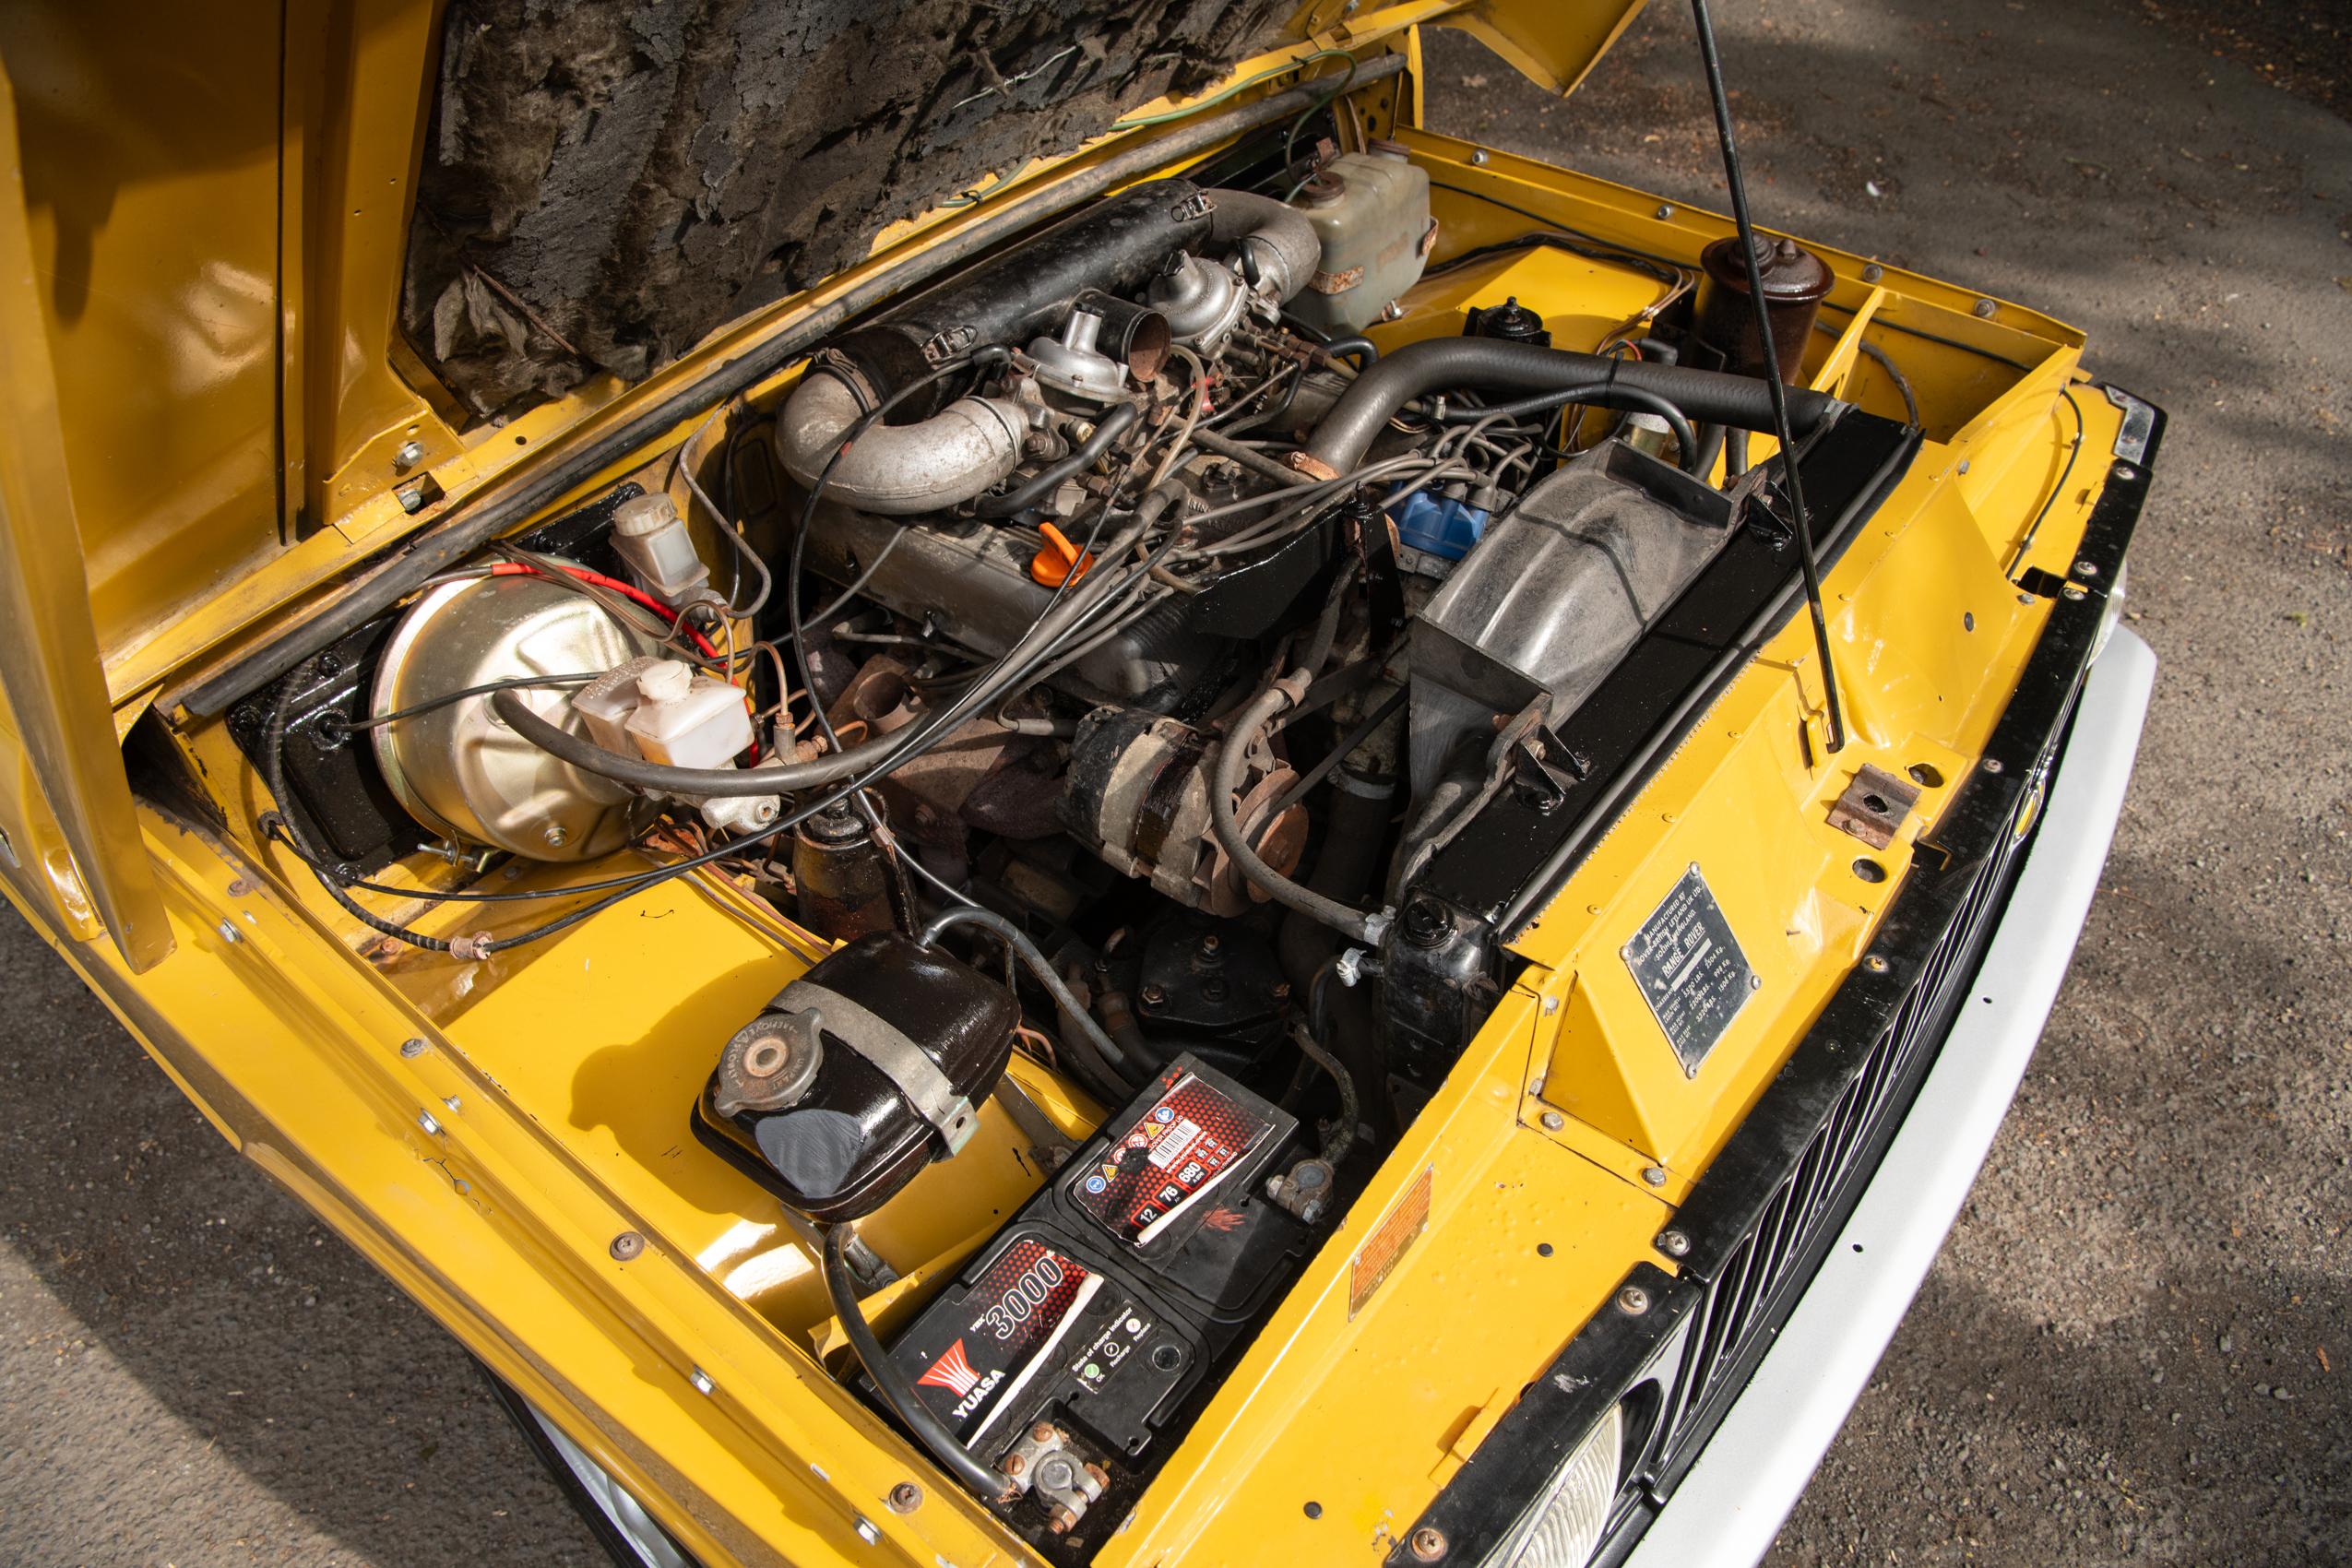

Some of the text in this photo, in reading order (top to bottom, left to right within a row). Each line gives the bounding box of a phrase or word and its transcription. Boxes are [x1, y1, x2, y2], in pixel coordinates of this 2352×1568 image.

[1645, 890, 1686, 942] MANUFACTURED BY
[1668, 902, 1688, 928] LEYLAND
[1686, 894, 1693, 905] UK
[1661, 946, 1683, 977] RANGE
[1688, 992, 1702, 1011] 2200
[1713, 964, 1723, 980] 998
[1161, 1120, 1177, 1135] PROOF
[1166, 1131, 1207, 1173] www.yuasa.com
[1178, 1161, 1201, 1184] 680
[1159, 1185, 1178, 1202] 76
[1140, 1208, 1157, 1224] 12
[986, 1255, 1063, 1340] 3000
[1071, 1305, 1134, 1372] State of charge indicator
[1095, 1322, 1152, 1383] OK Recharge Replace
[951, 1367, 1006, 1420] YUASA
